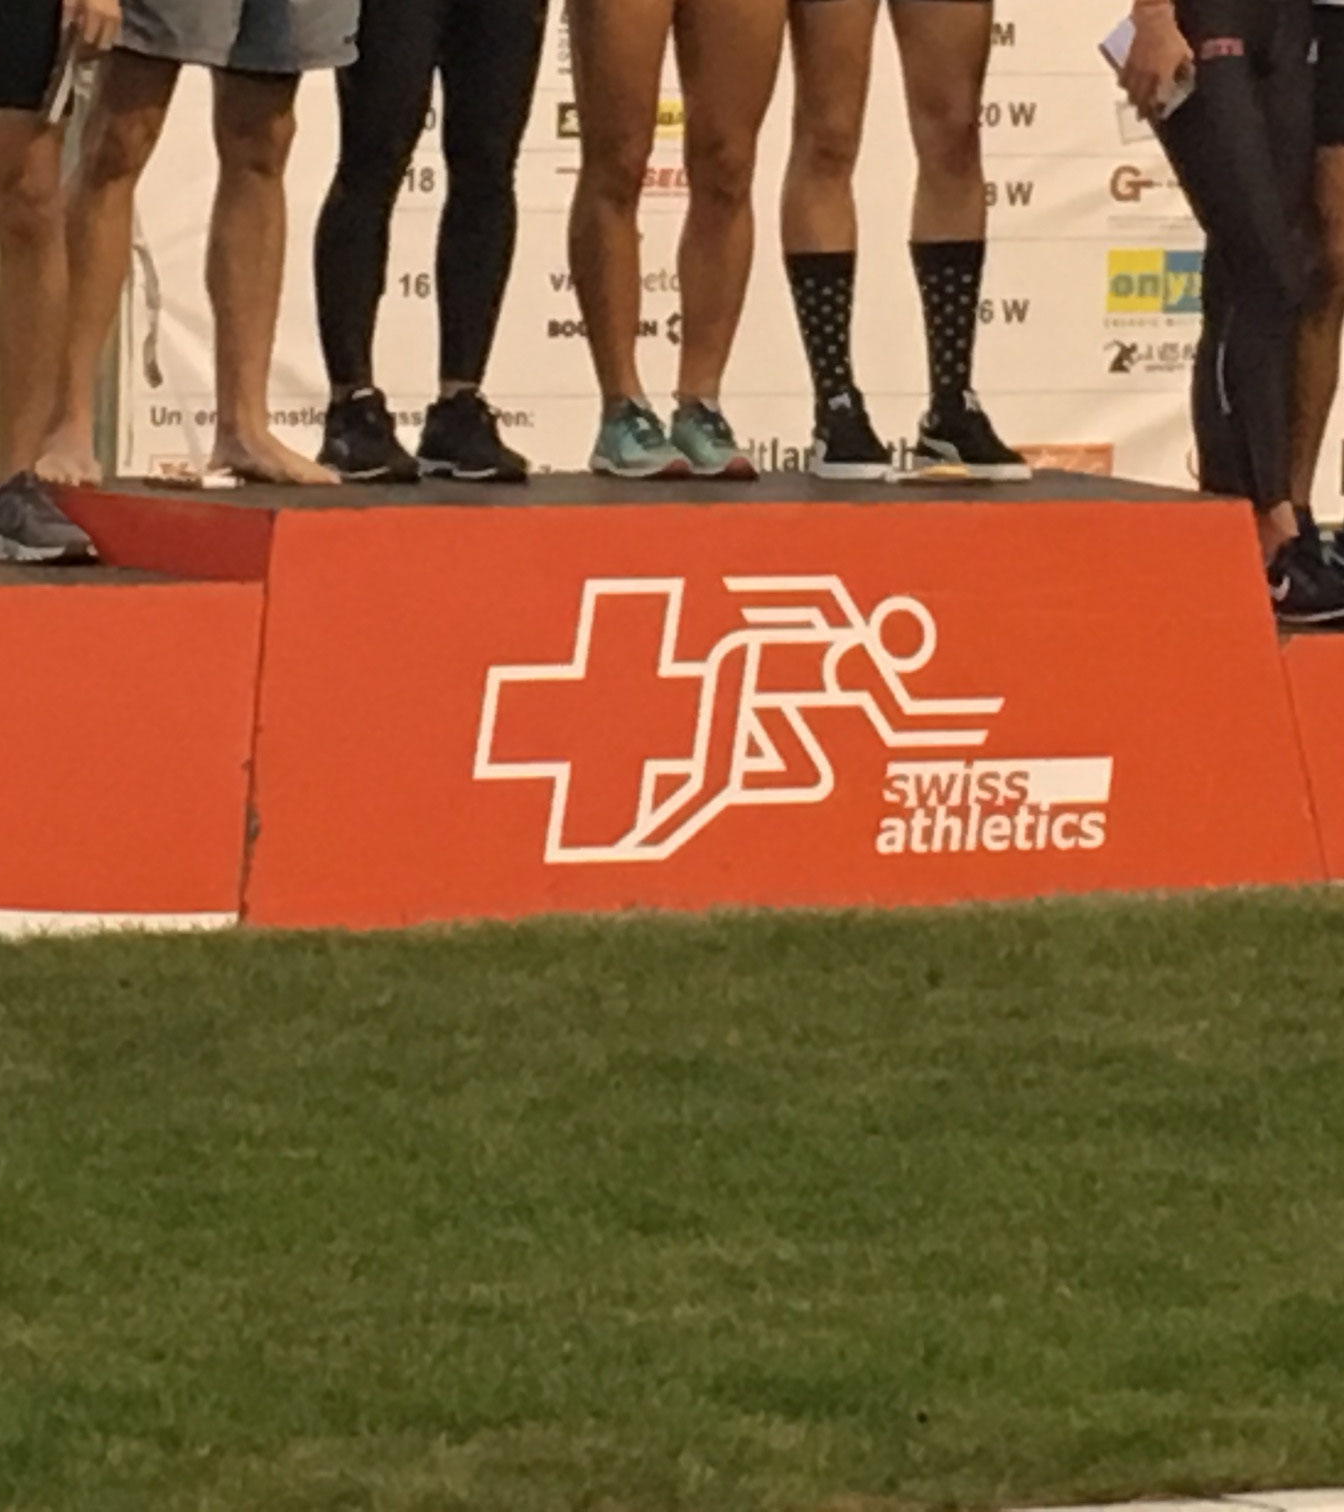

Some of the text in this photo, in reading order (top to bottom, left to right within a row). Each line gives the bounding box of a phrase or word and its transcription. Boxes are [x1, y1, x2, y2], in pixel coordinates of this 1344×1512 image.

[399, 272, 431, 299] 16
[883, 756, 1030, 808] swiss
[875, 800, 1107, 855] athletics
